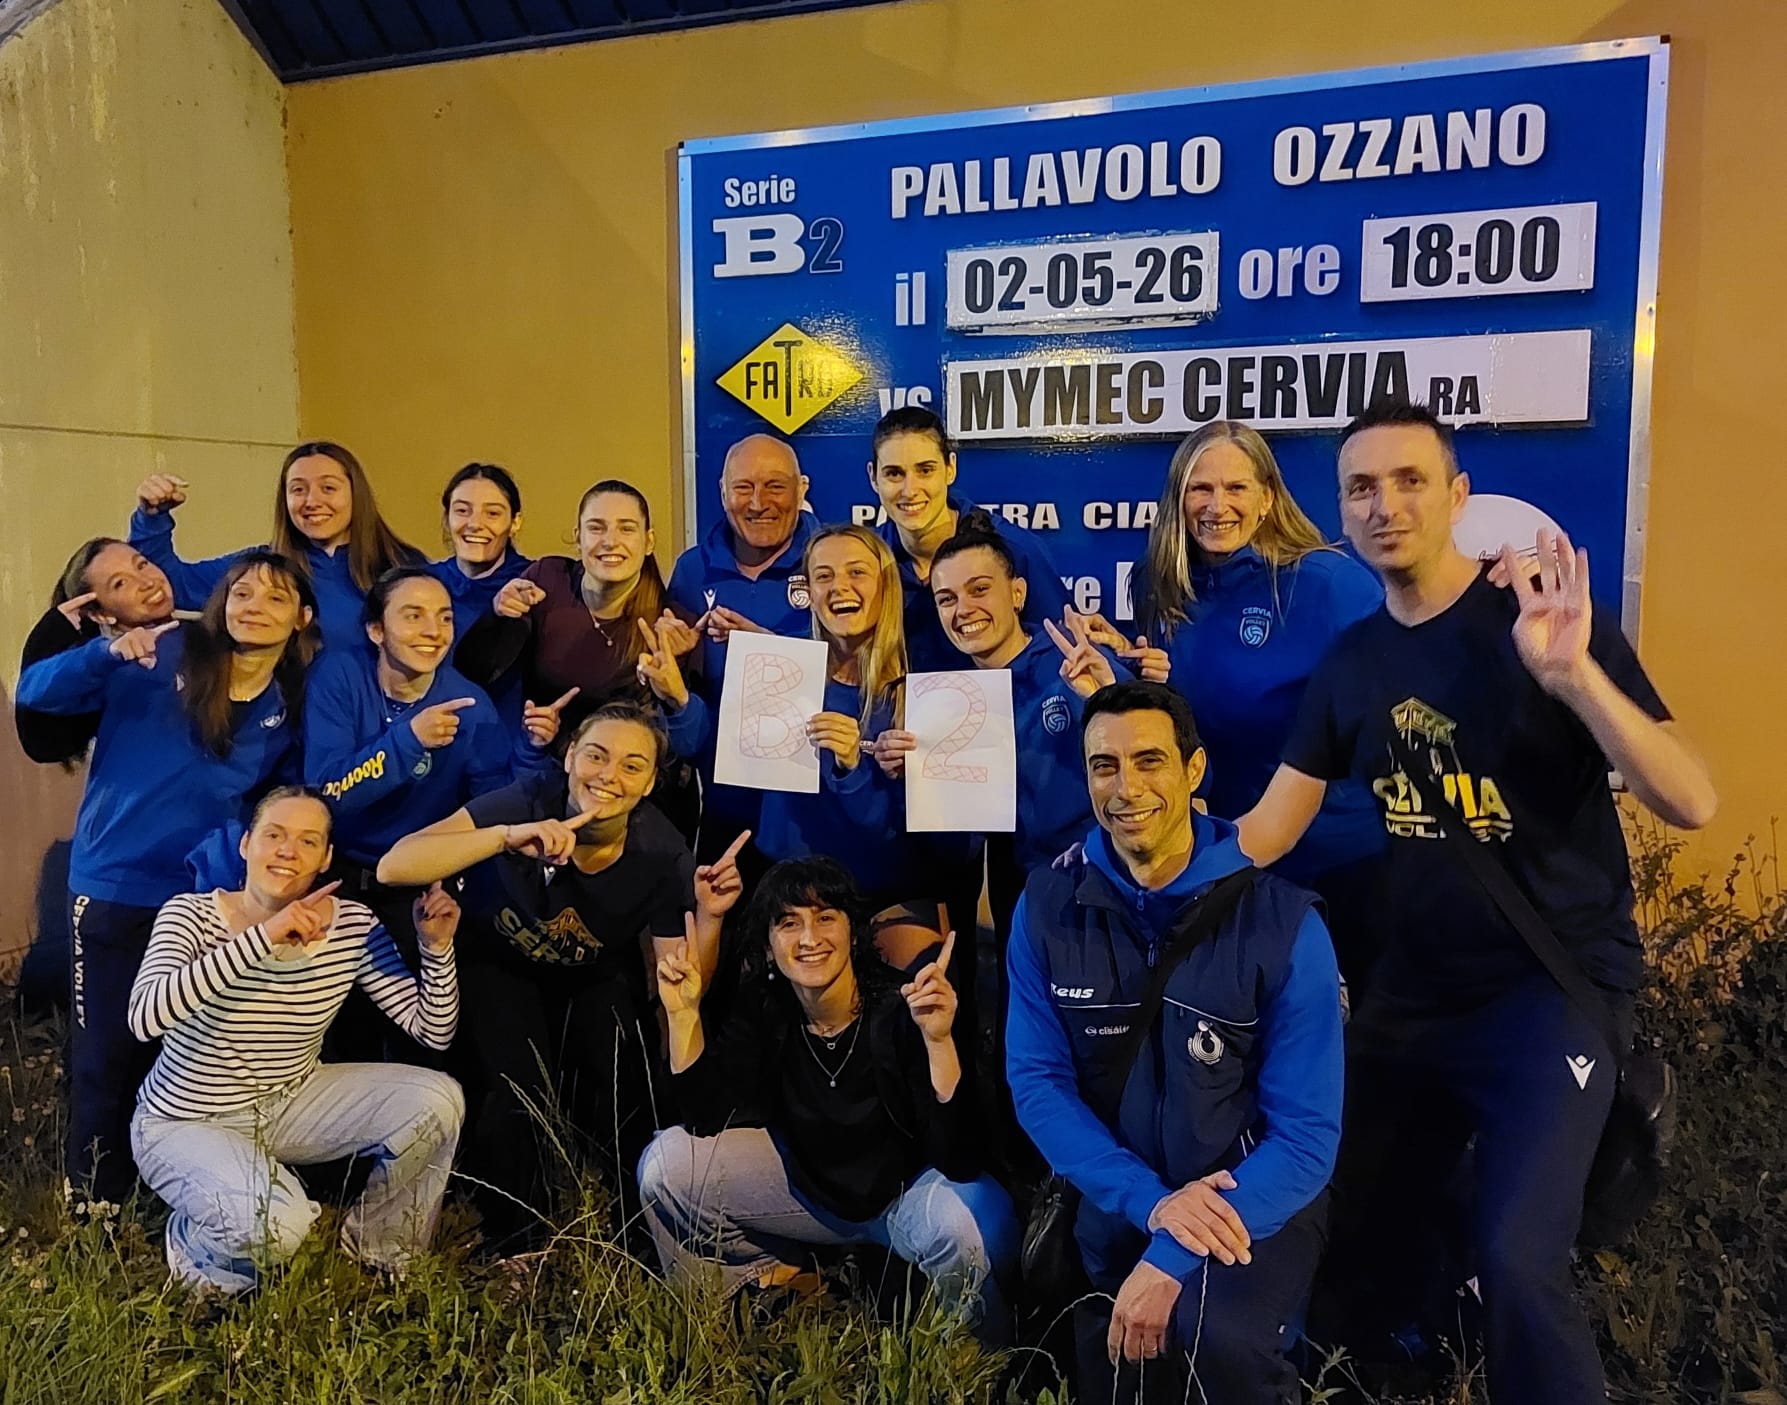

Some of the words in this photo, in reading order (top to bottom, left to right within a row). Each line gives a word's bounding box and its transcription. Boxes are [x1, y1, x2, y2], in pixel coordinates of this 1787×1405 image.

[724, 174, 796, 208] Serie
[891, 136, 1221, 219] PALLAVOLO
[1274, 103, 1547, 186] OZZANO
[712, 213, 844, 278] B2
[895, 271, 926, 326] il
[965, 245, 1205, 314] 02-05-26
[1238, 243, 1341, 299] ore
[1382, 215, 1561, 290] 18:00
[878, 386, 932, 418] vs
[959, 360, 1165, 433] MYMEC
[1183, 350, 1410, 422] CERVIA
[1427, 375, 1481, 416] RA
[1242, 606, 1272, 618] CERVIA
[739, 652, 807, 760] B
[912, 672, 988, 783] 2
[1041, 695, 1067, 709] CERVIA
[74, 961, 87, 1029] VOLLEY
